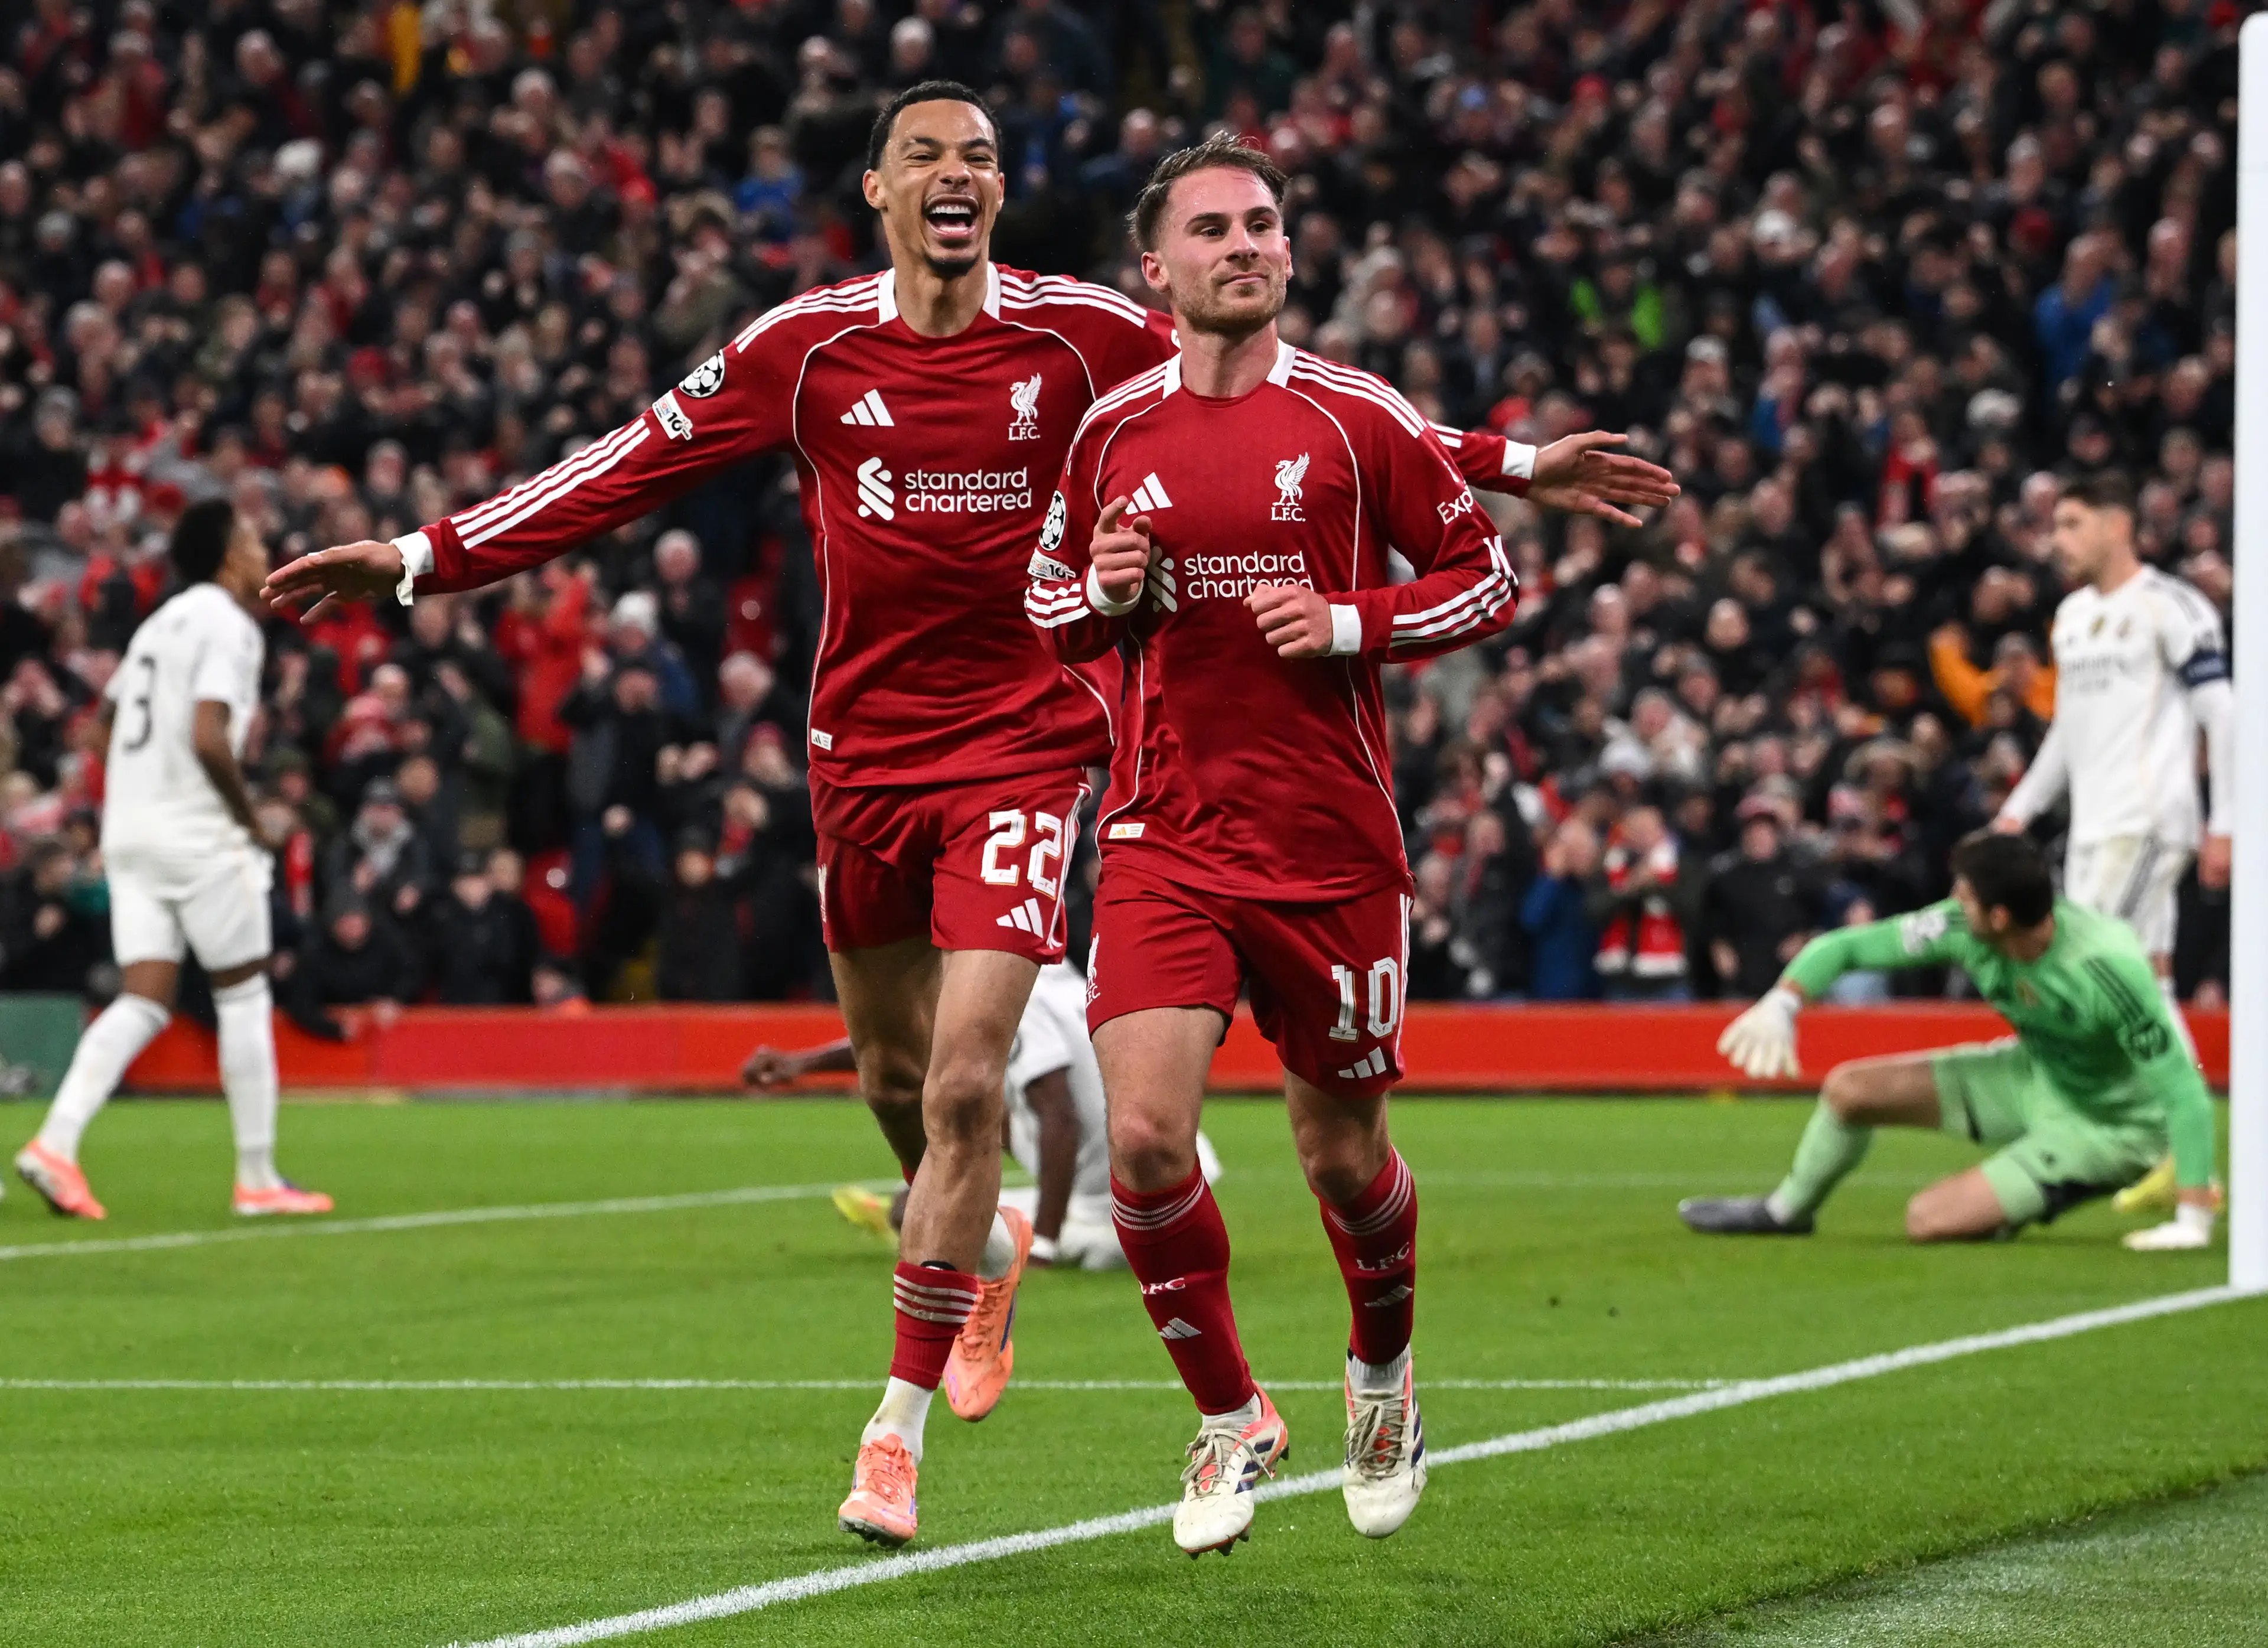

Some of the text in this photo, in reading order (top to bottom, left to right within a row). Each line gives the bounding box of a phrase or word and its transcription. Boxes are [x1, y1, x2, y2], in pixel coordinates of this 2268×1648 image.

[1008, 426, 1041, 441] L.F.C.
[905, 466, 1027, 490] standard
[905, 487, 1032, 513] chartered
[1271, 507, 1306, 522] L.F.C.
[1049, 564, 1066, 578] 10
[1184, 550, 1305, 576] standard
[123, 654, 156, 753] 3
[980, 809, 1063, 901] 22
[1329, 956, 1400, 1043] 10
[1355, 1241, 1410, 1271] LFC
